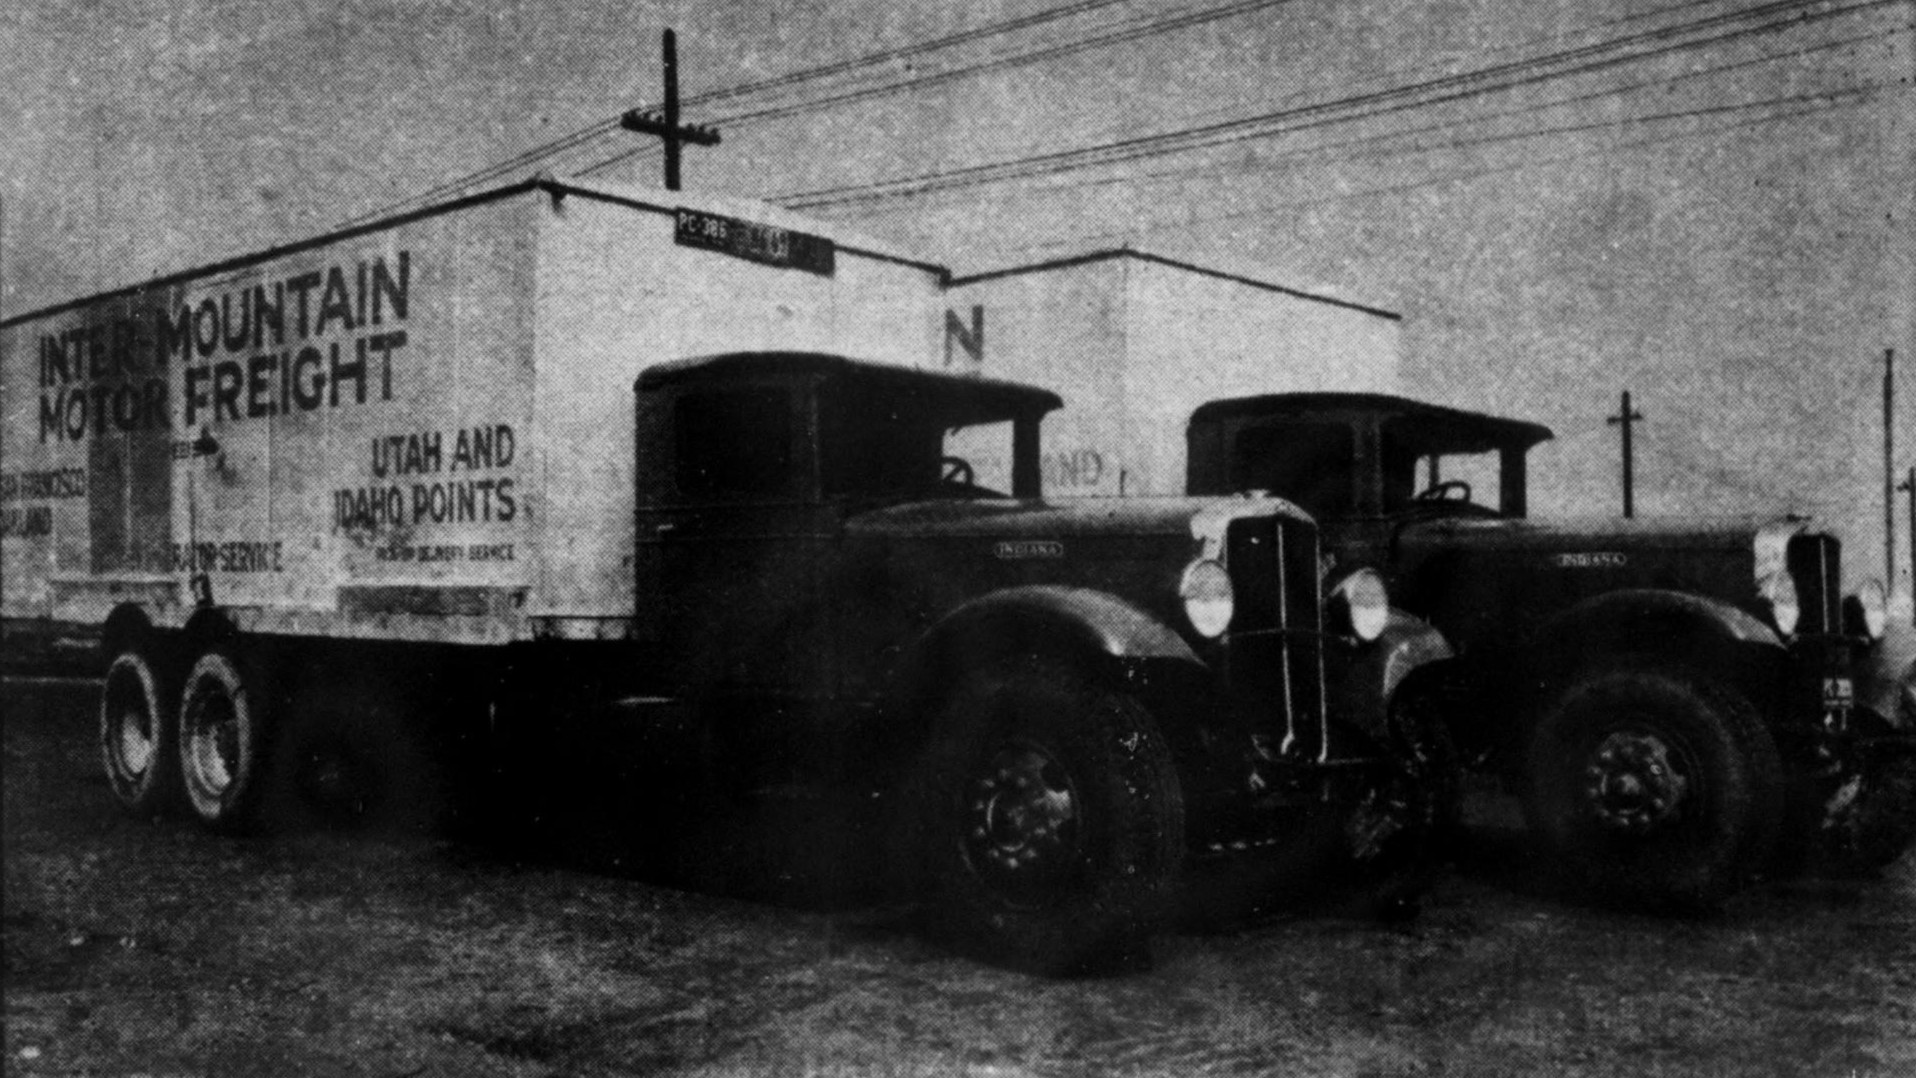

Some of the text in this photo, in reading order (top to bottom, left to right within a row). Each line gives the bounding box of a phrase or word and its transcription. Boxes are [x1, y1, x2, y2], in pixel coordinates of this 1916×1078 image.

[39, 330, 408, 445] MOTOR FREIGHT
[372, 424, 515, 478] UTAH AND
[334, 477, 516, 531] IDAHO POINTS
[998, 542, 1059, 559] INDIANA
[1560, 552, 1620, 567] INDIANA
